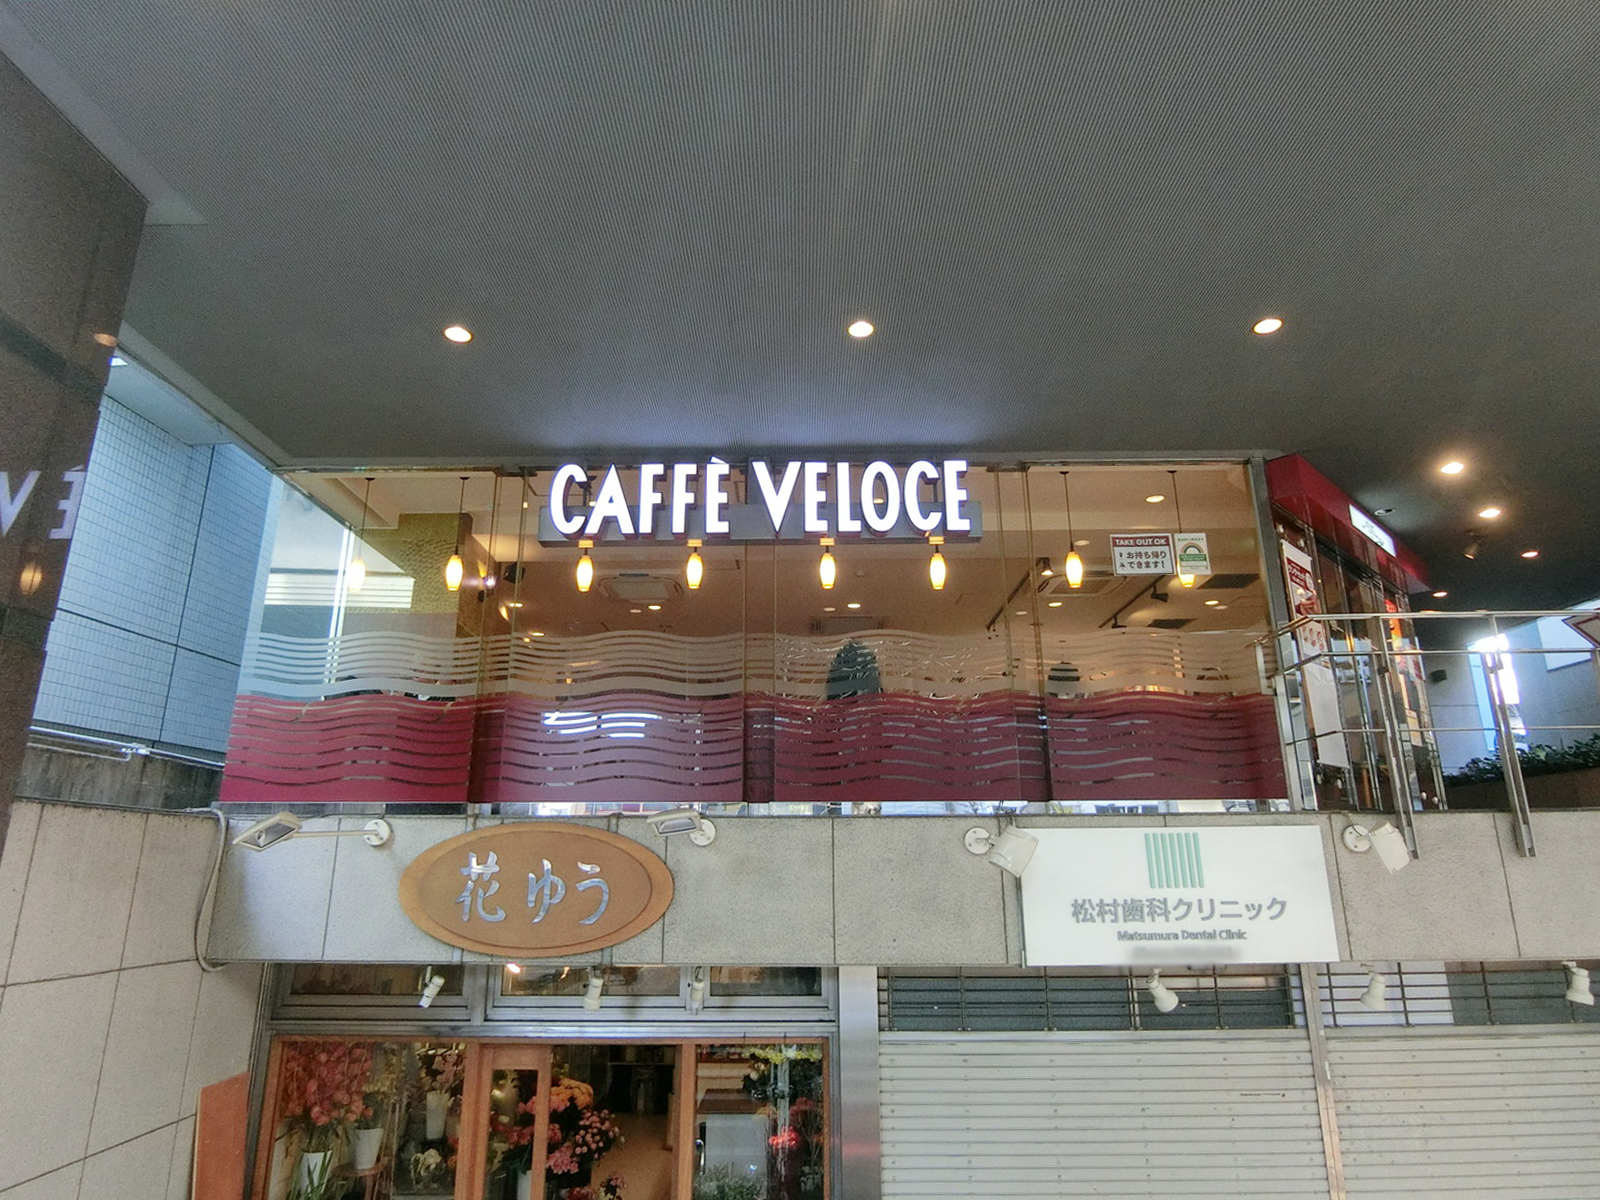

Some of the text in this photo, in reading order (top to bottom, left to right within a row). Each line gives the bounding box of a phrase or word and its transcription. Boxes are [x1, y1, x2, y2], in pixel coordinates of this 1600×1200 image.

[549, 456, 972, 535] CAFFÈ VELOCE
[1115, 537, 1167, 546] TAKE OUT OK
[1126, 551, 1167, 559] お持ち帰り
[455, 851, 610, 925] 花ゆう
[1071, 897, 1287, 924] 松村歯科クリニック
[1117, 929, 1247, 941] Matsumura Dental Clinic
